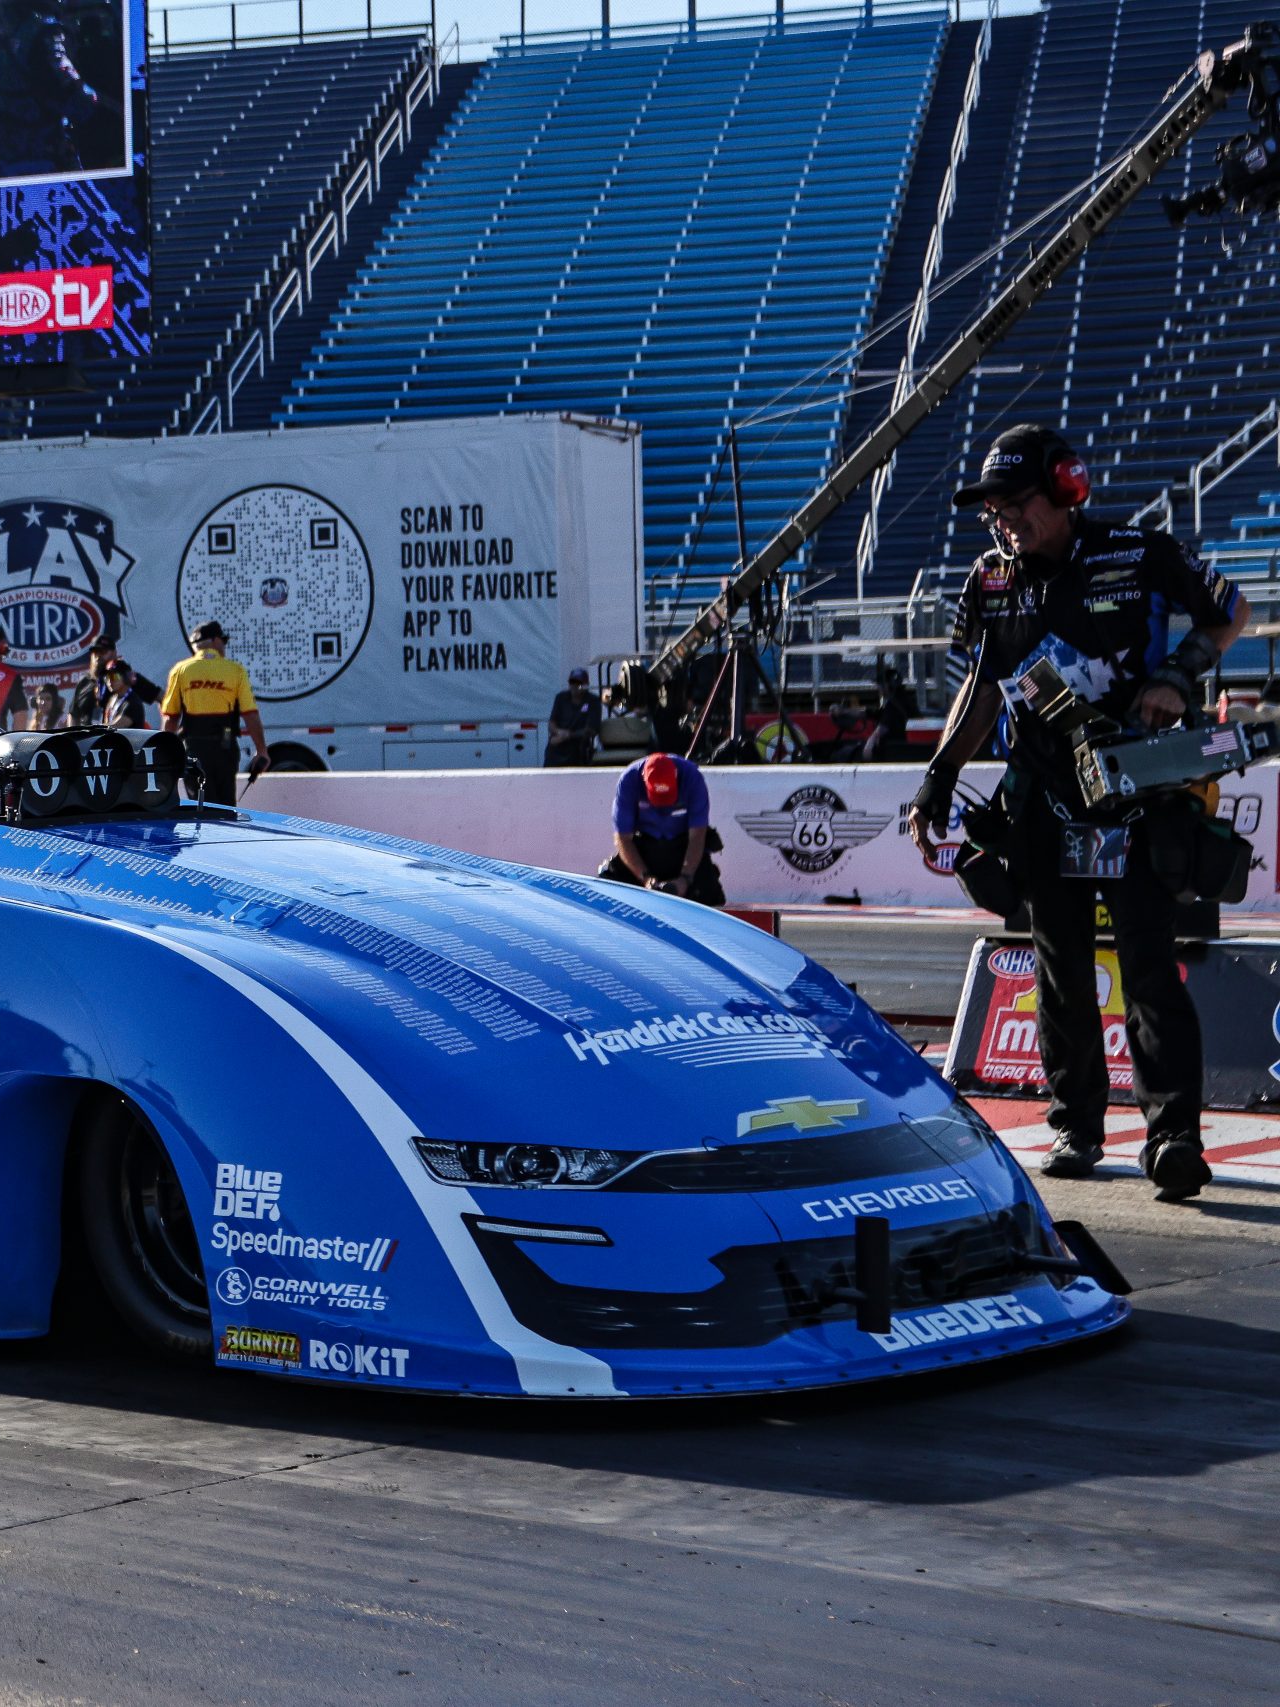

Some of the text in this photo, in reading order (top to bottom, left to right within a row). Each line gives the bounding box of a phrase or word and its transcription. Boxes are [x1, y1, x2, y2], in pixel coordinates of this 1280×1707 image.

[401, 504, 484, 534] SCAN TO
[401, 538, 513, 569] DOWNLOAD
[402, 571, 558, 603] YOUR FAVORITE
[403, 609, 472, 638] APP TO
[34, 645, 78, 662] RACING
[403, 642, 507, 672] PLAYNHRA
[797, 809, 829, 819] ROUTE
[798, 823, 828, 847] 66
[563, 1012, 822, 1066] HendrickCars.com
[982, 1065, 1022, 1081] DRAG
[215, 1163, 283, 1192] Blue
[213, 1189, 281, 1220] DEF
[802, 1178, 978, 1222] CHEVROLET
[211, 1222, 370, 1264] Speedmaster
[252, 1290, 386, 1311] QUALITY TOOLS
[254, 1276, 386, 1299] CORNWELL
